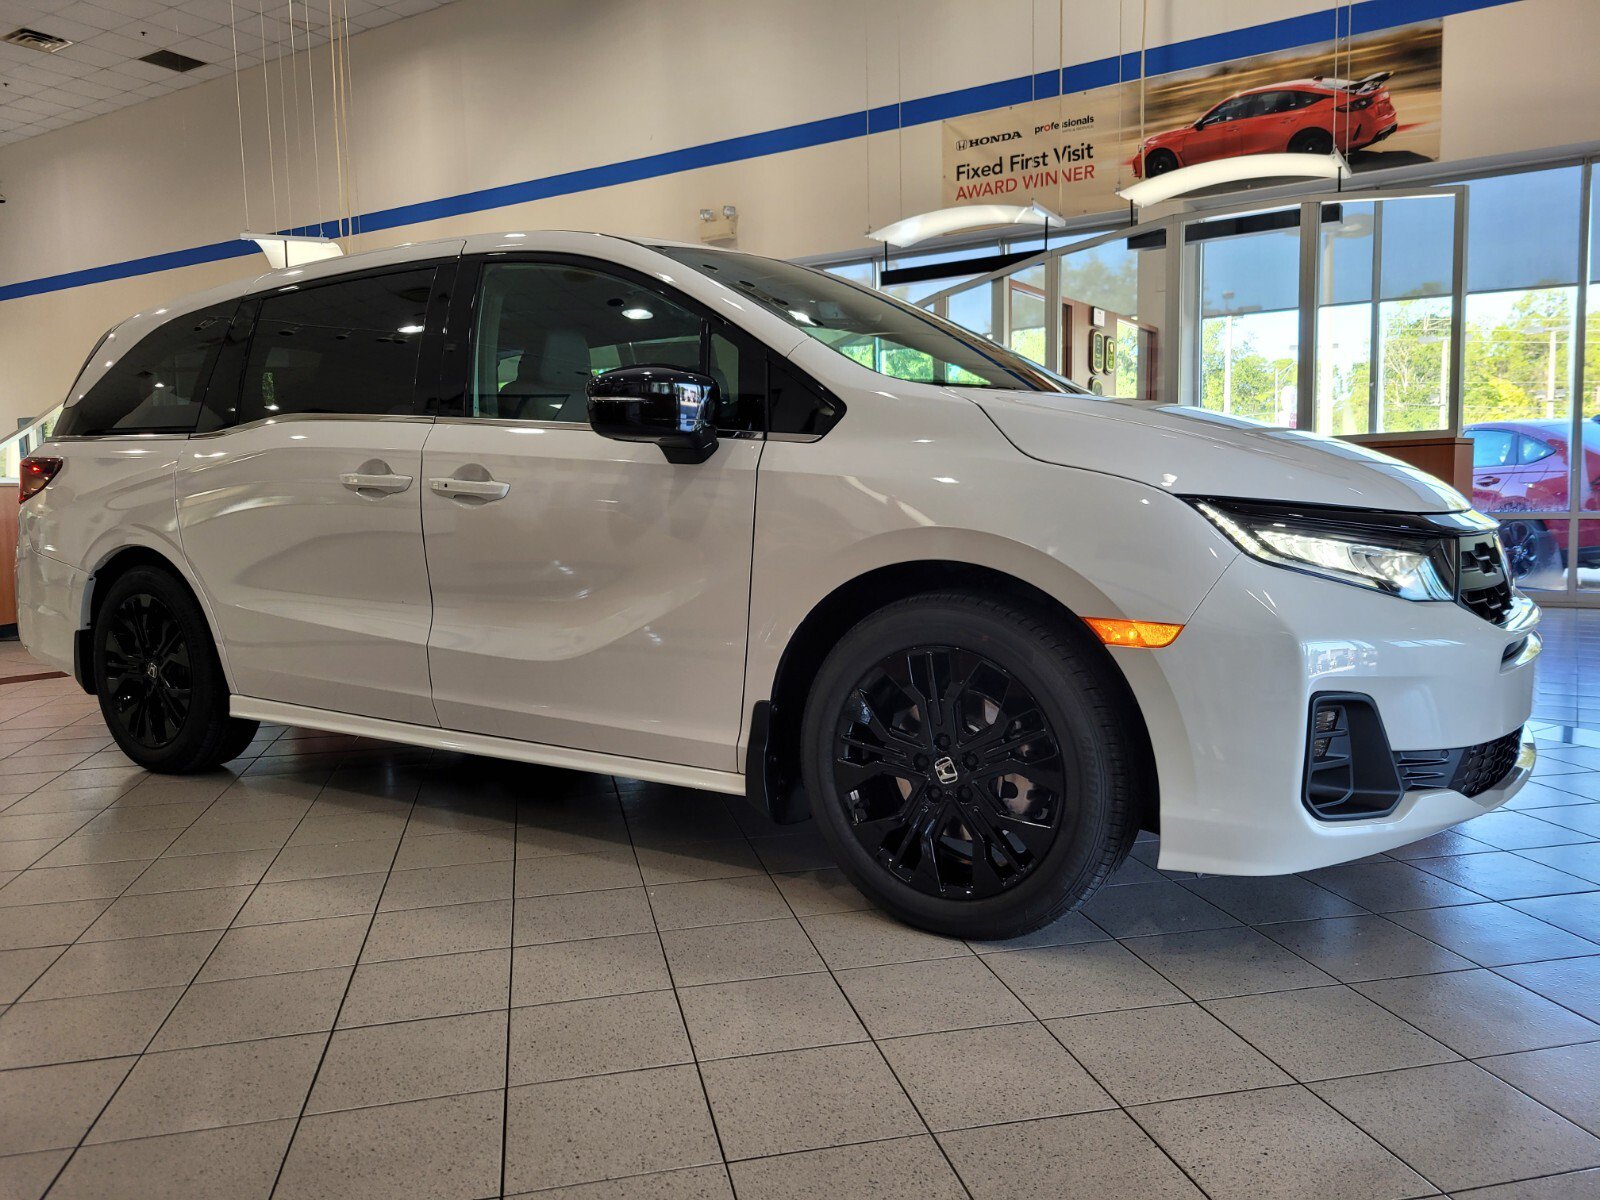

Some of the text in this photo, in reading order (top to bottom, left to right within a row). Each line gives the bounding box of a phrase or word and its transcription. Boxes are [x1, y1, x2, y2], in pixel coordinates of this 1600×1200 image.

[968, 131, 1023, 148] HONDA
[956, 143, 1094, 181] Fixed First Visit
[955, 164, 1095, 201] AWARD WINNER
